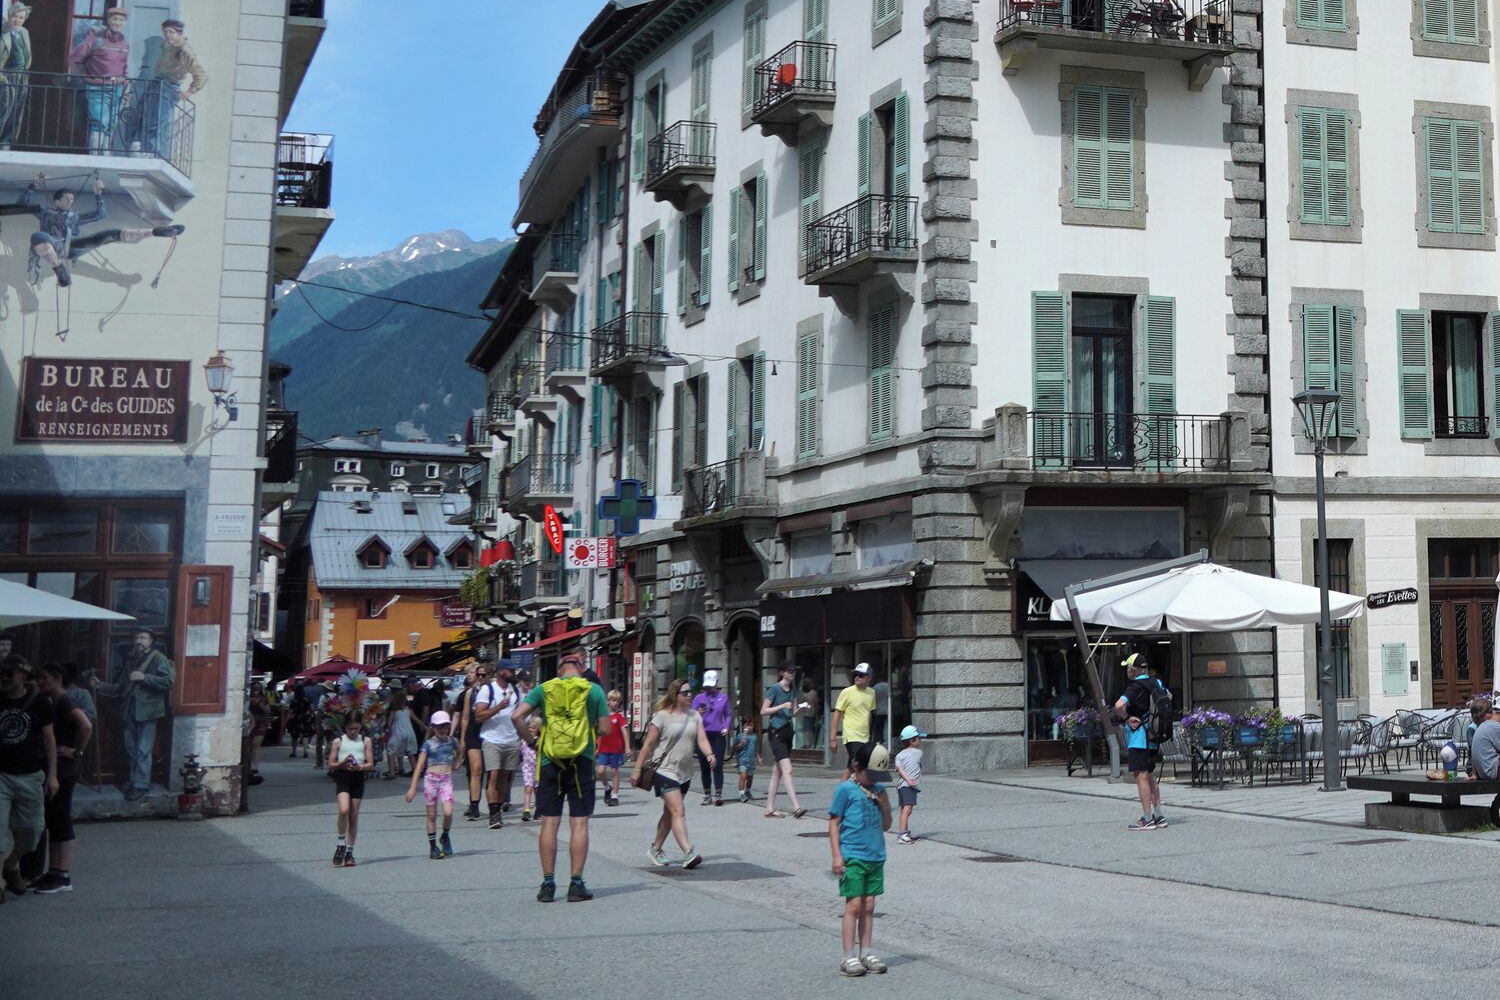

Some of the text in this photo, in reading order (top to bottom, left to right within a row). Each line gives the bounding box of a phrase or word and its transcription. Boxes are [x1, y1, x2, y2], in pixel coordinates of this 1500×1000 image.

[40, 364, 172, 389] BUREAU
[36, 395, 52, 413] de
[56, 396, 67, 413] la
[91, 396, 113, 414] des
[116, 397, 175, 415] GUIDES
[38, 423, 168, 437] RENSEIGNEMENTS
[548, 513, 560, 545] TABAC
[598, 538, 609, 567] BURGER
[1387, 591, 1417, 603] Evettes
[634, 656, 642, 729] BURGER
